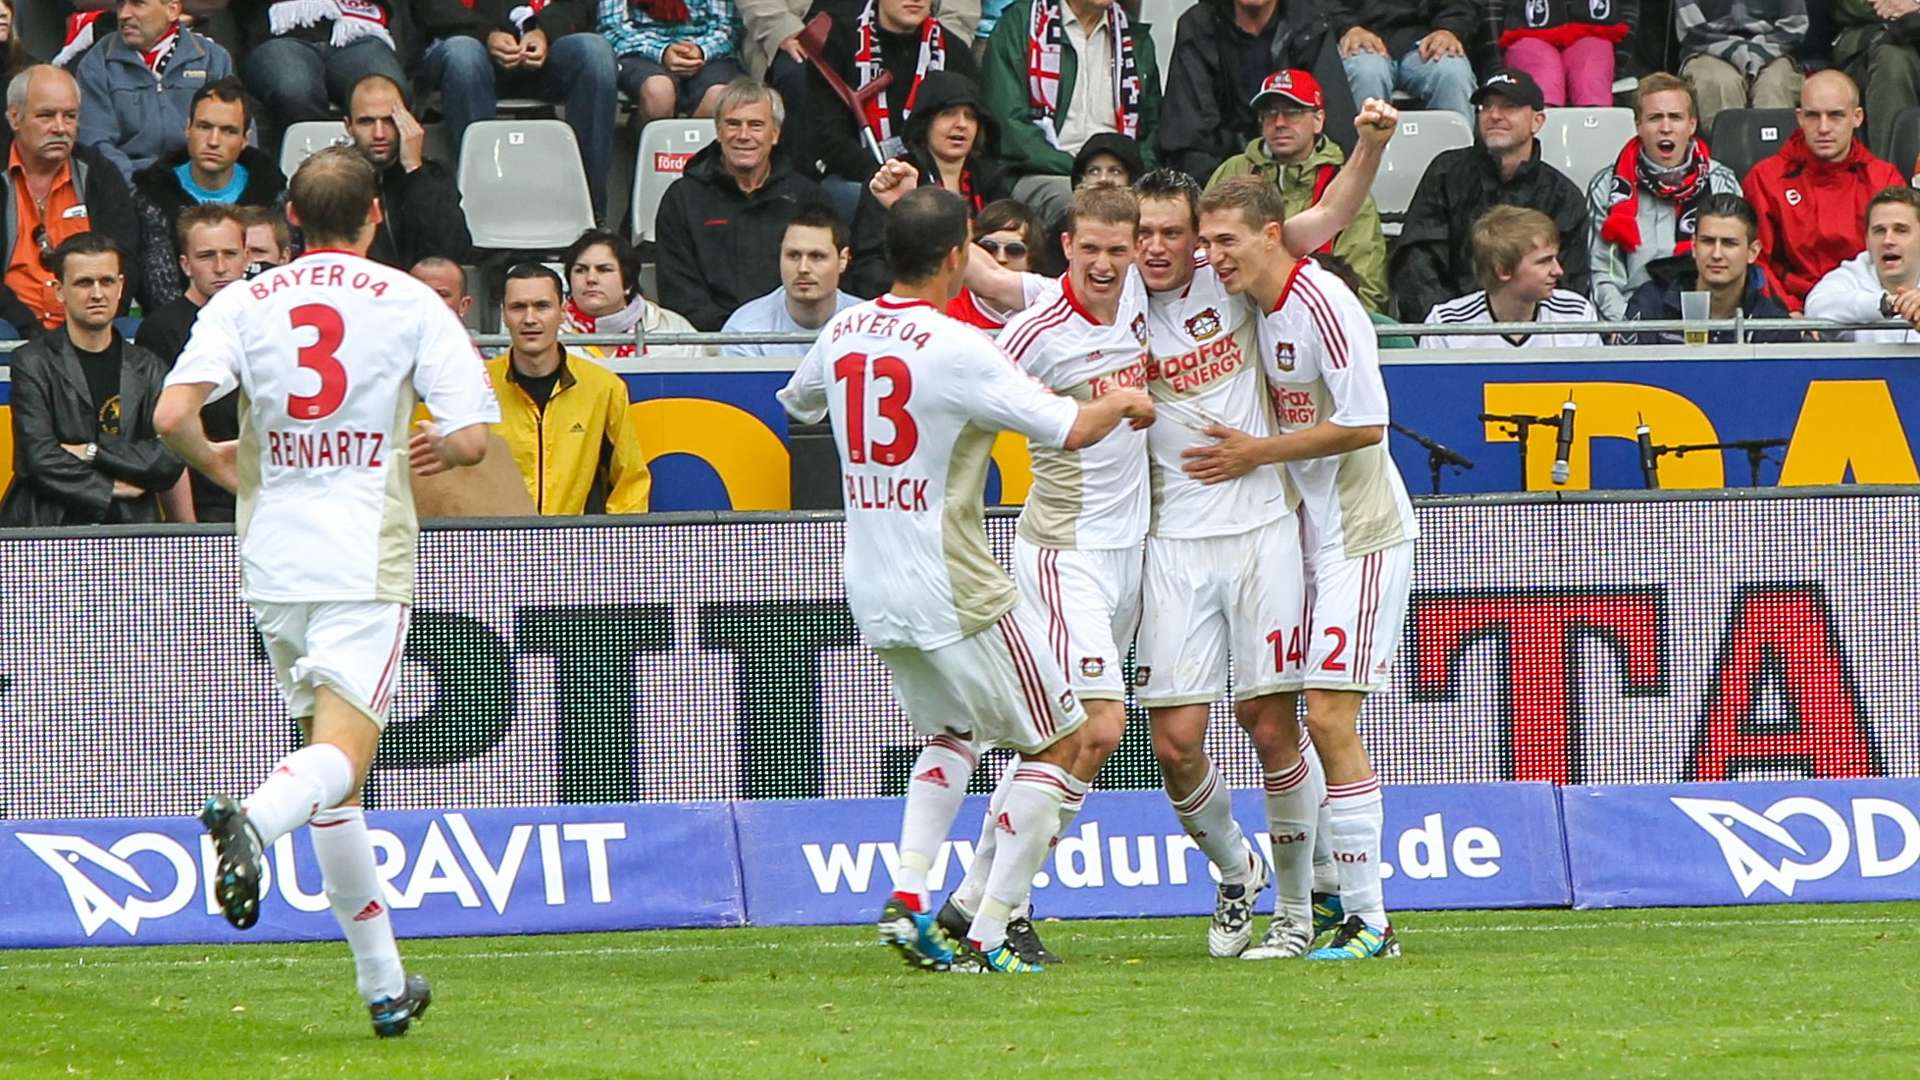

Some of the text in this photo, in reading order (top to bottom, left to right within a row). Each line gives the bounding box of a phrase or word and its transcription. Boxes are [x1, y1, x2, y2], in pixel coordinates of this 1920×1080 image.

[250, 264, 389, 300] BAYER 04
[832, 312, 931, 351] BAYER 04
[287, 302, 349, 421] 3
[1172, 349, 1243, 393] ENERGY
[833, 351, 919, 467] 13
[268, 430, 385, 468] REINARTZ
[1265, 625, 1302, 673] 14
[1320, 626, 1347, 671] 2
